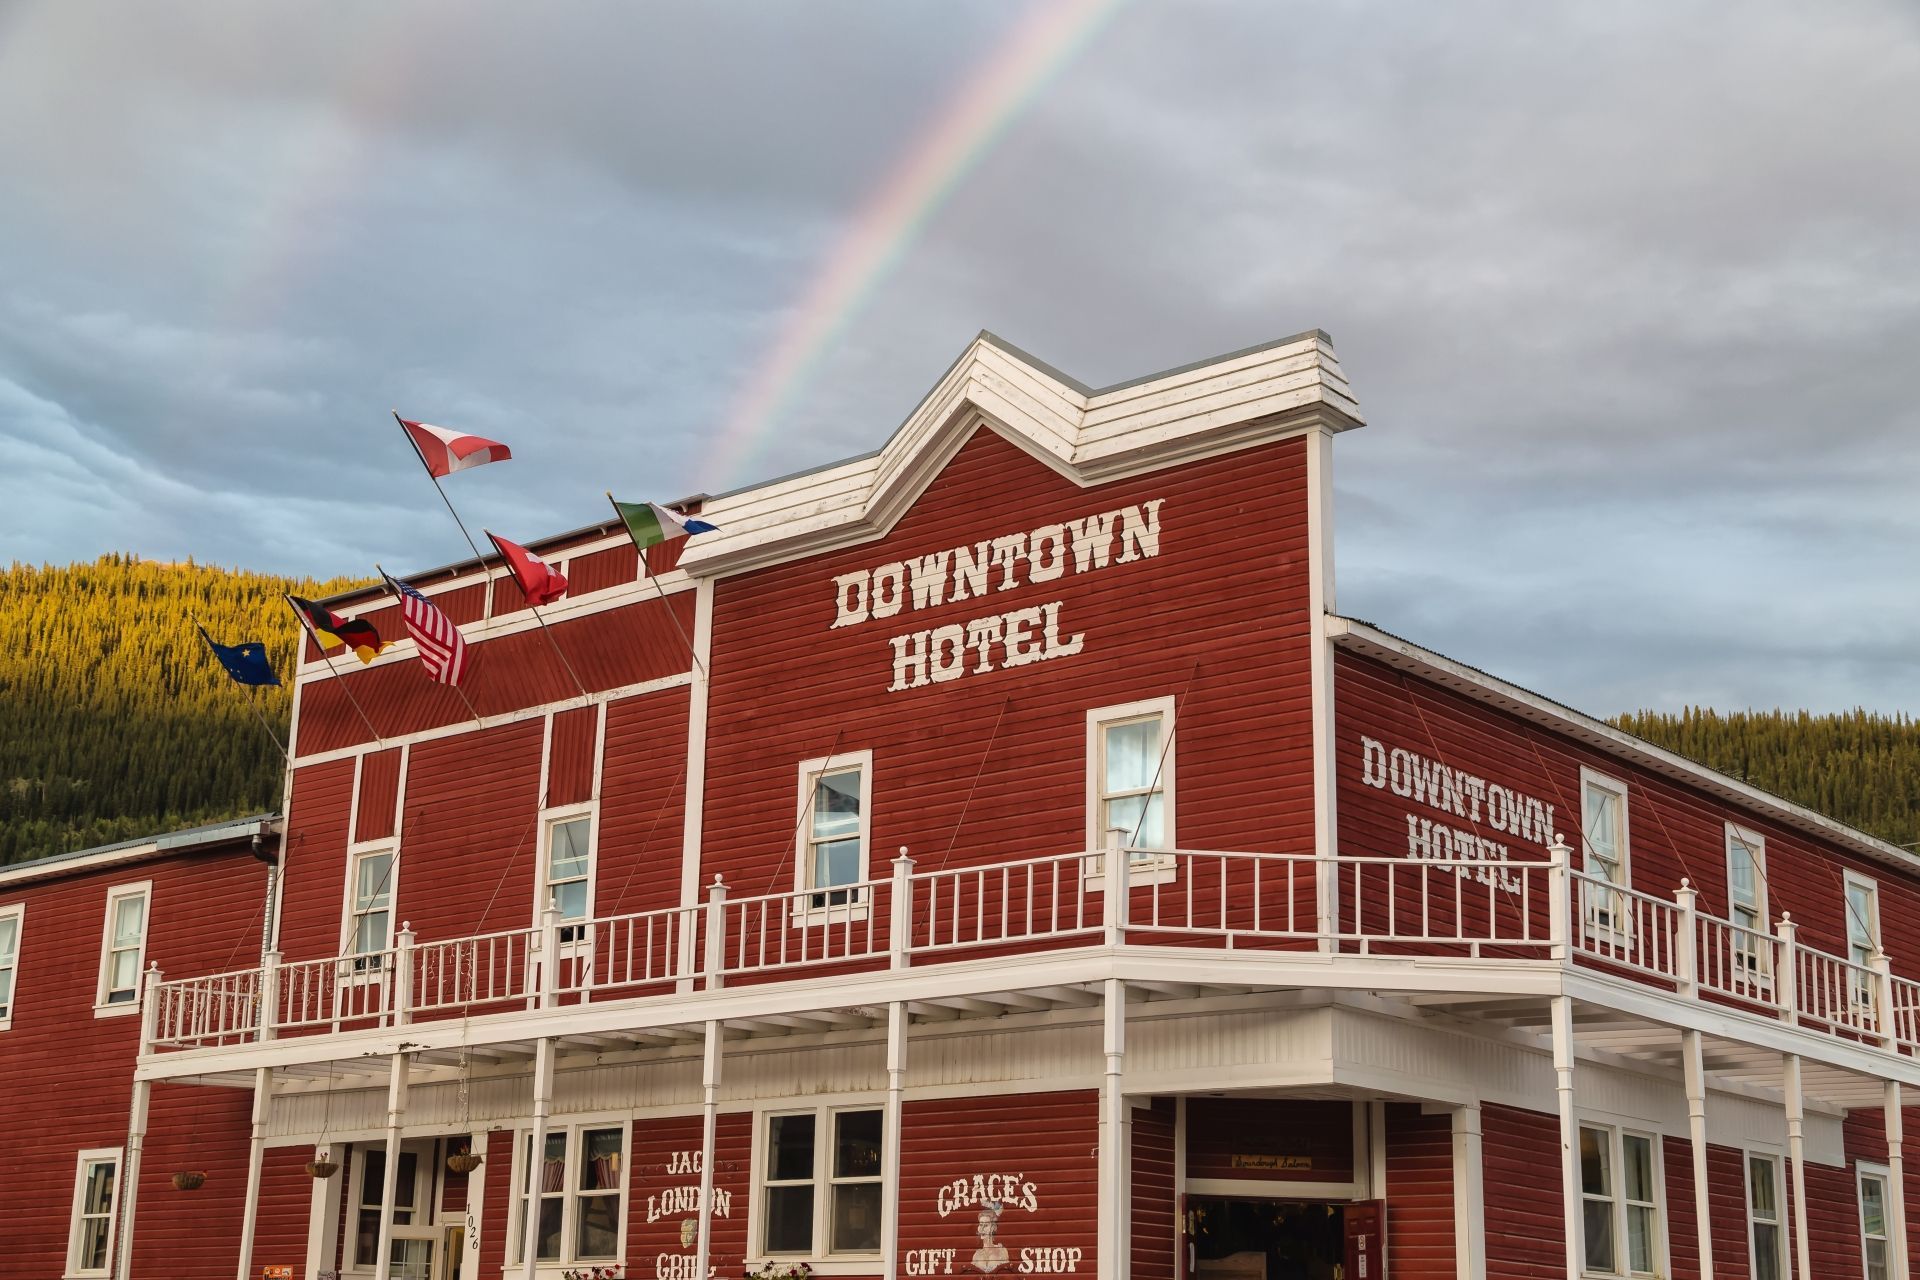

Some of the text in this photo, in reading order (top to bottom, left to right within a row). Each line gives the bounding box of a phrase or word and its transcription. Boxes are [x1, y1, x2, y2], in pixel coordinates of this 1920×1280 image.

[830, 498, 1166, 629] DOWNTOWN
[887, 601, 1086, 692] HOTEL
[1361, 735, 1554, 847] DOWNTOWN
[1406, 814, 1521, 895] HOTEL
[666, 1151, 715, 1174] JAC
[937, 1173, 1038, 1217] GRACE'S
[466, 1203, 479, 1249] 1026
[656, 1253, 717, 1280] GRI
[906, 1247, 1082, 1276] GIFT SHOP
